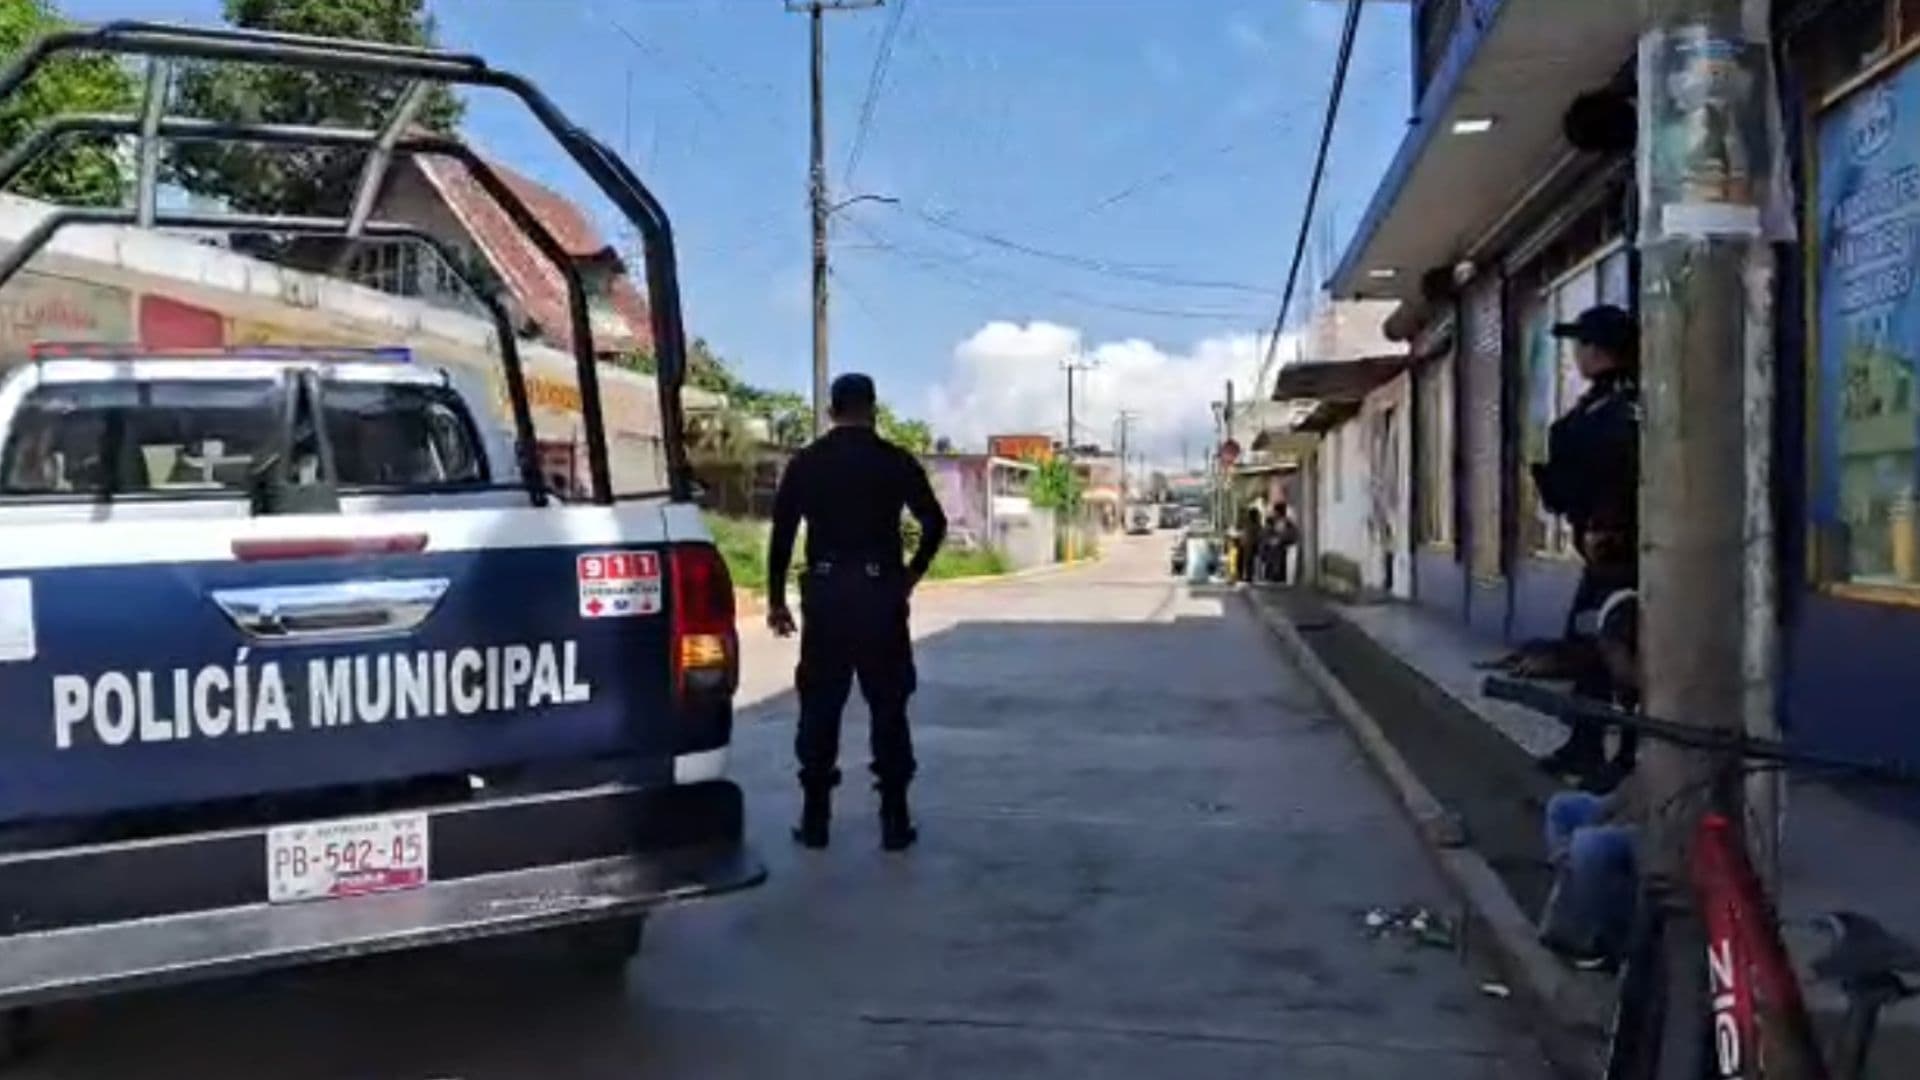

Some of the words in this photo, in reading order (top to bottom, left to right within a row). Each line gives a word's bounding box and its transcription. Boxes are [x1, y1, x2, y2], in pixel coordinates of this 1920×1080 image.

[584, 556, 650, 577] 911
[53, 646, 293, 748] POLICÍA
[308, 640, 590, 727] MUNICIPAL
[1707, 938, 1743, 1080] ZIG
